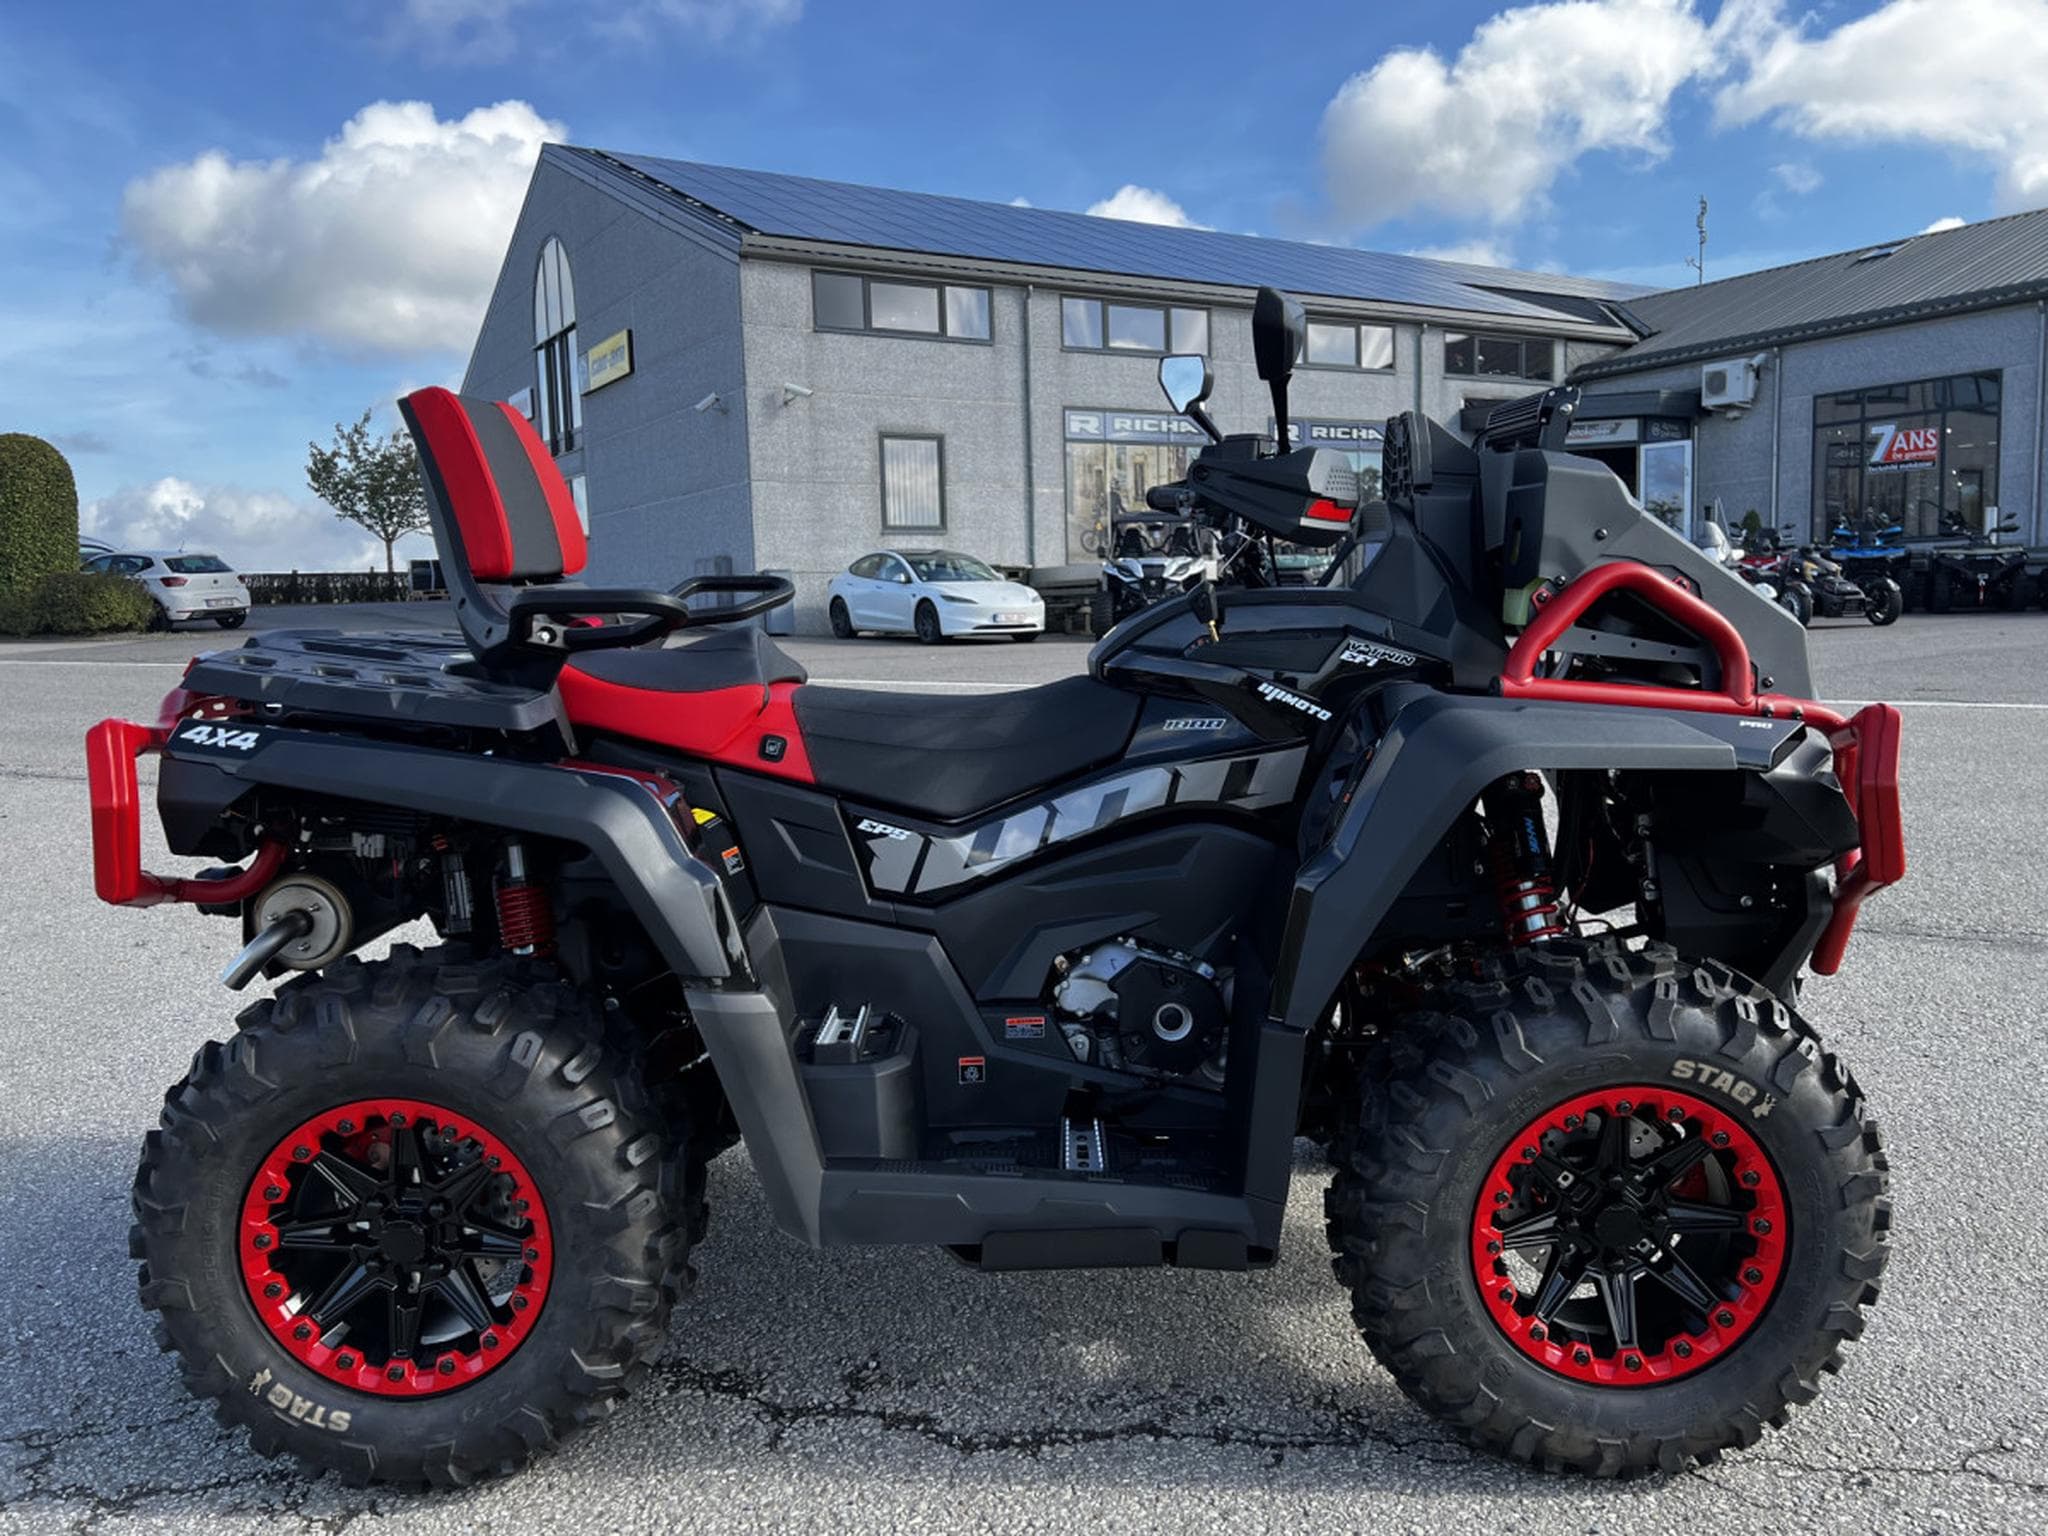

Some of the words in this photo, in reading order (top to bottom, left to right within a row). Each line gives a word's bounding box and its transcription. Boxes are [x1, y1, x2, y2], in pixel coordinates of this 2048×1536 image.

[1113, 417, 1199, 434] RICHA
[1892, 429, 1937, 452] ANS
[1339, 649, 1379, 667] EFI
[179, 724, 260, 751] 4X4
[856, 818, 912, 841] EPS
[1671, 1059, 1758, 1106] STAG
[266, 1382, 353, 1432] STAG
